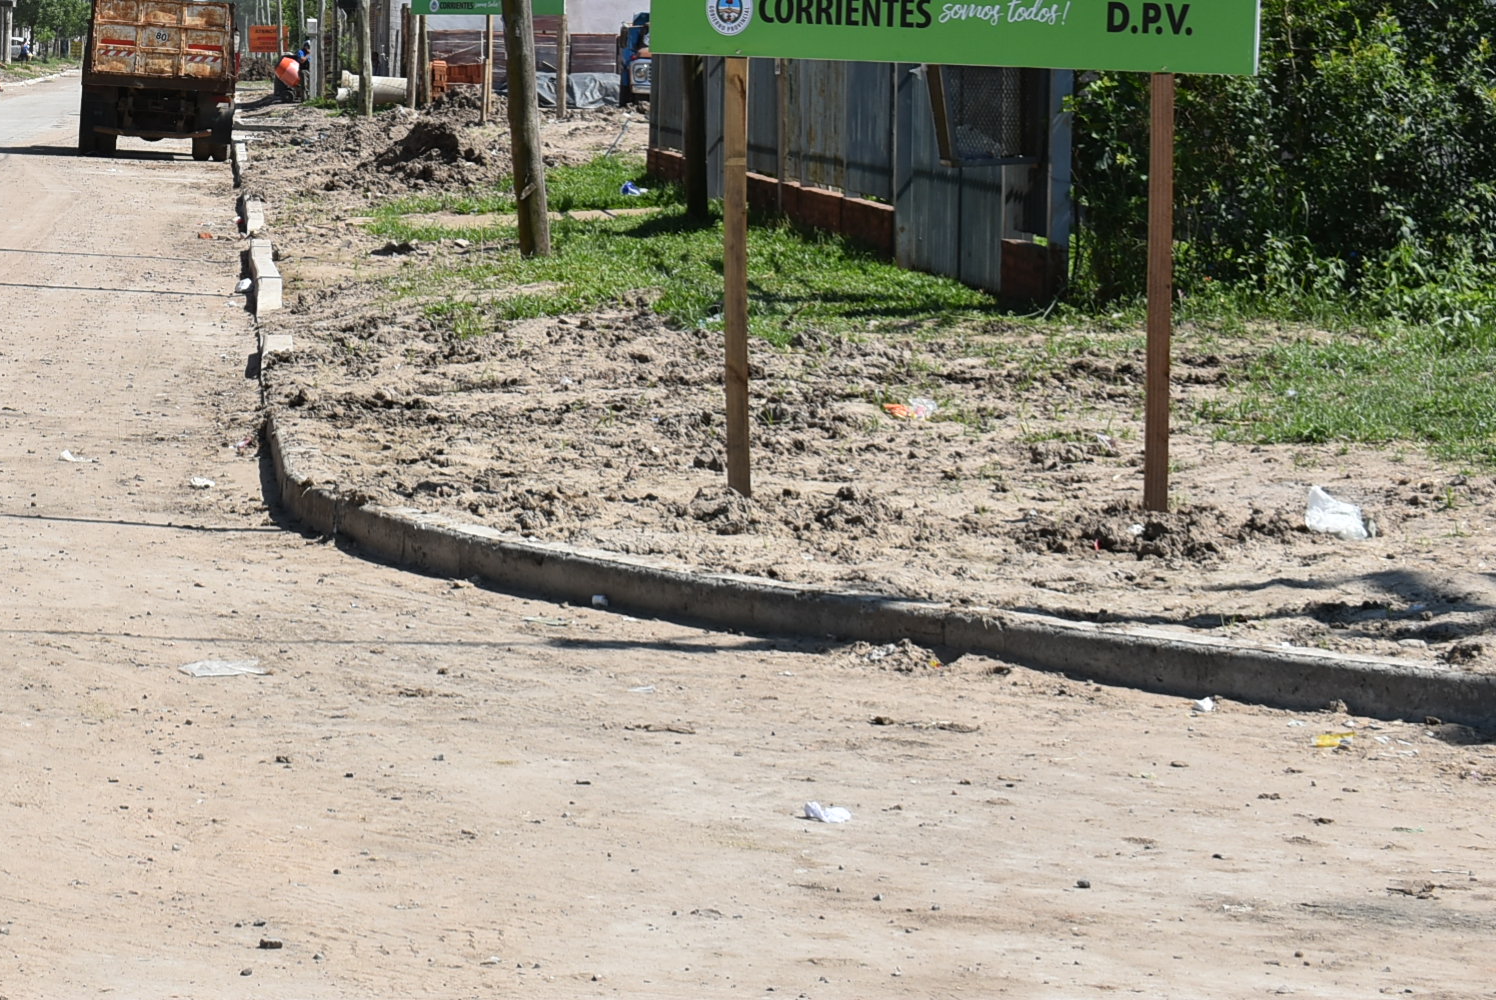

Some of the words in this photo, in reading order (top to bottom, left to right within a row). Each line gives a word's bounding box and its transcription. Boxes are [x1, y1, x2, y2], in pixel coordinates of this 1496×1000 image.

[938, 1, 1004, 26] somos
[1106, 1, 1193, 36] D.P.V.
[156, 32, 167, 41] 80
